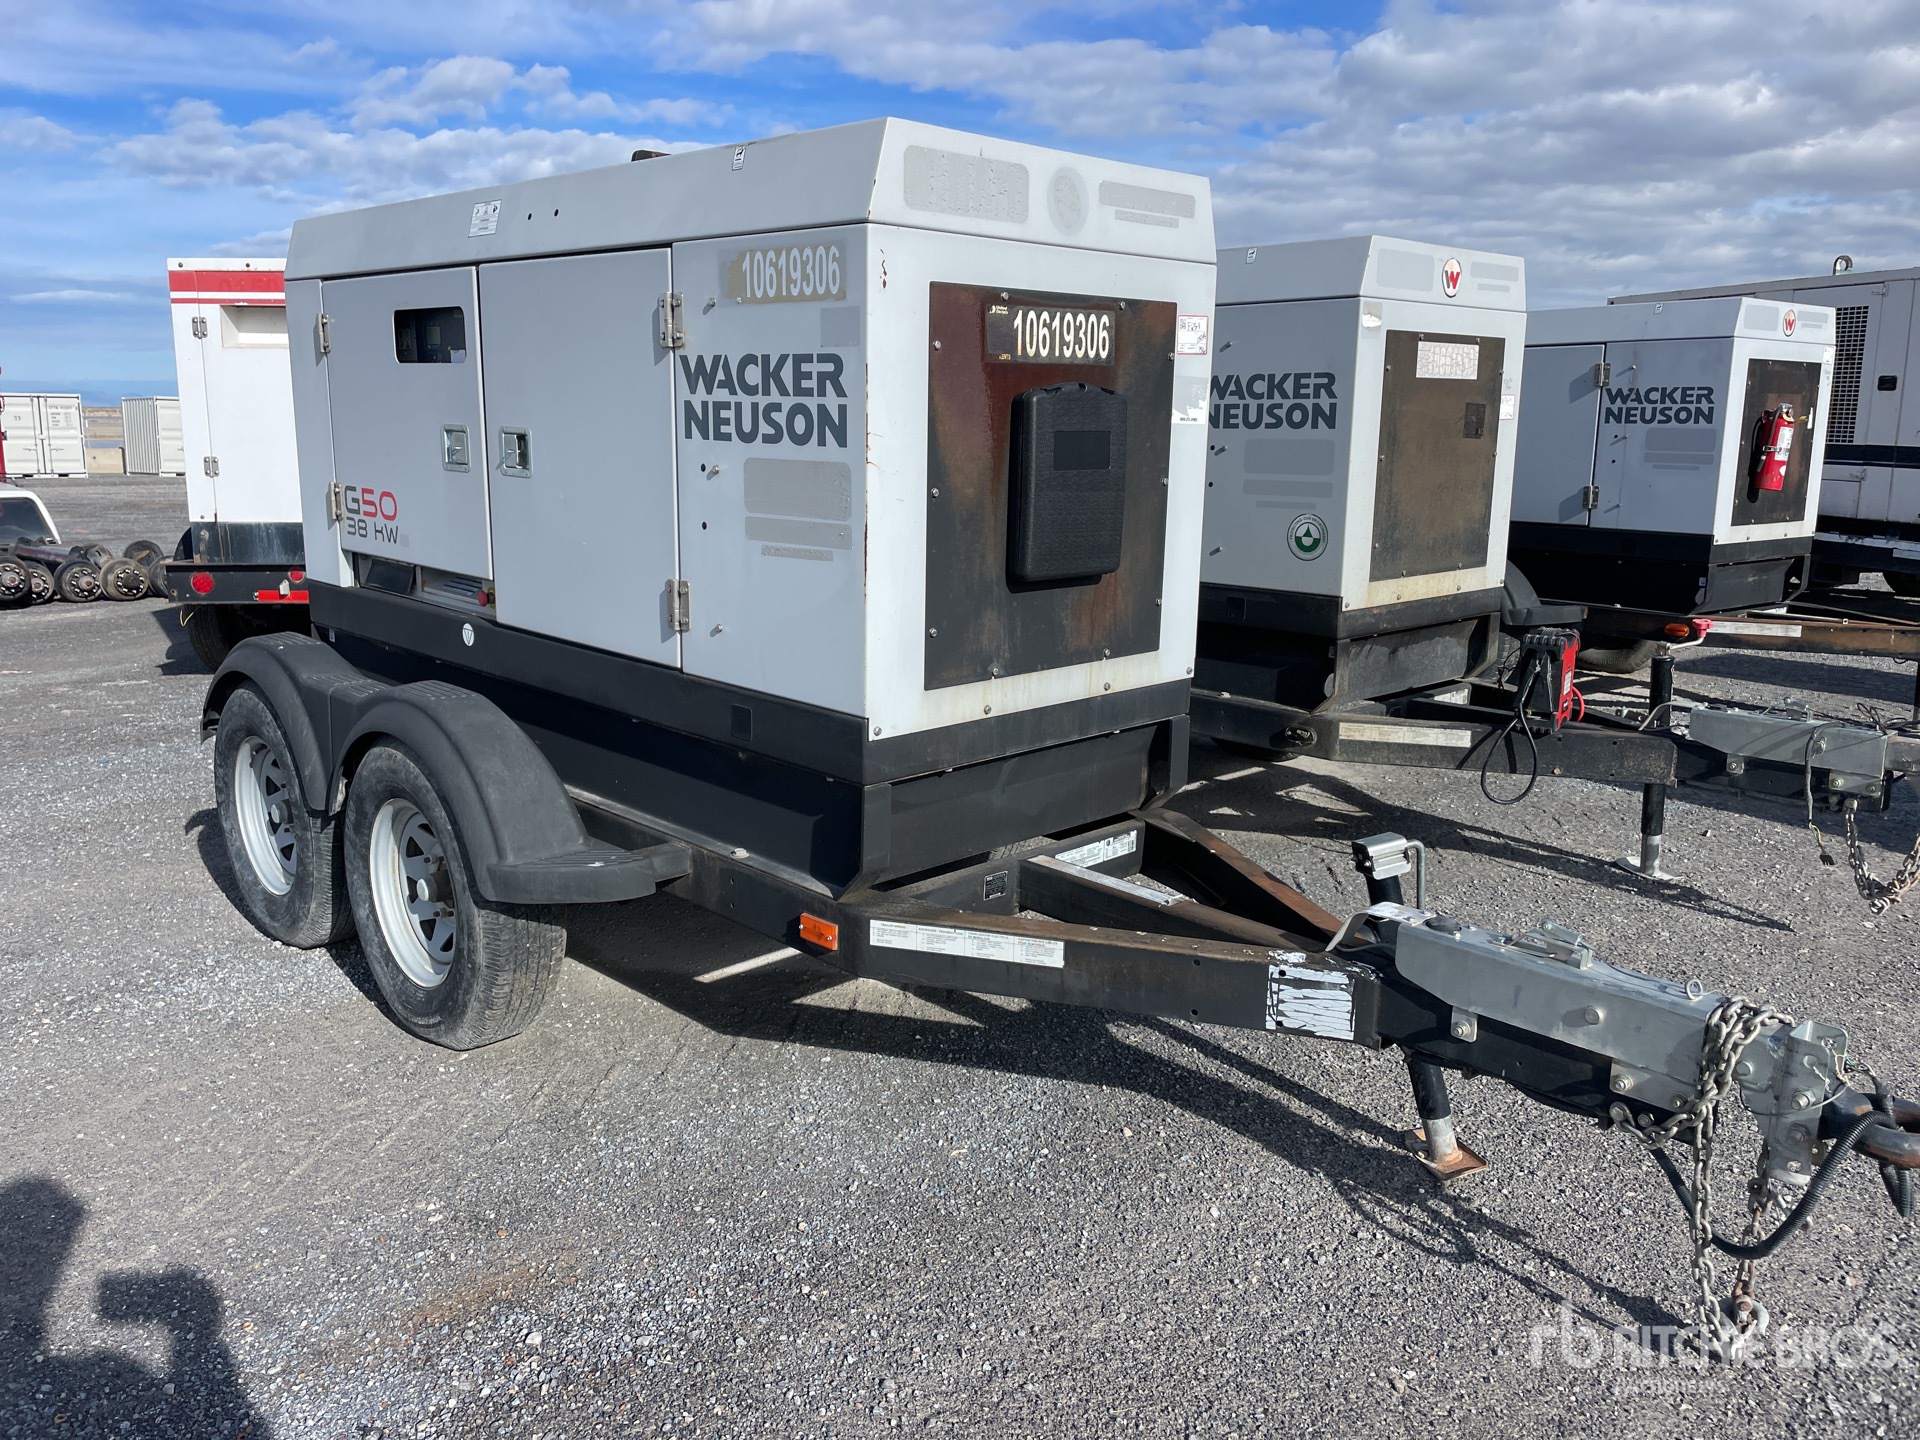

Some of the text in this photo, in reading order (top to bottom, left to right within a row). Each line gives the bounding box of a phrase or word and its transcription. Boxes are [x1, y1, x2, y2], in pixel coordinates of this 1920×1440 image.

[742, 245, 840, 299] 10619306
[1013, 309, 1110, 359] 10619306
[679, 353, 848, 398] WACKER
[1209, 372, 1338, 400] WACKER
[1605, 386, 1715, 405] WACKER
[683, 400, 848, 448] NEUSON
[1209, 402, 1337, 430] NEUSON
[1604, 406, 1714, 424] NEUSON
[344, 485, 398, 522] G50
[346, 516, 368, 539] 38
